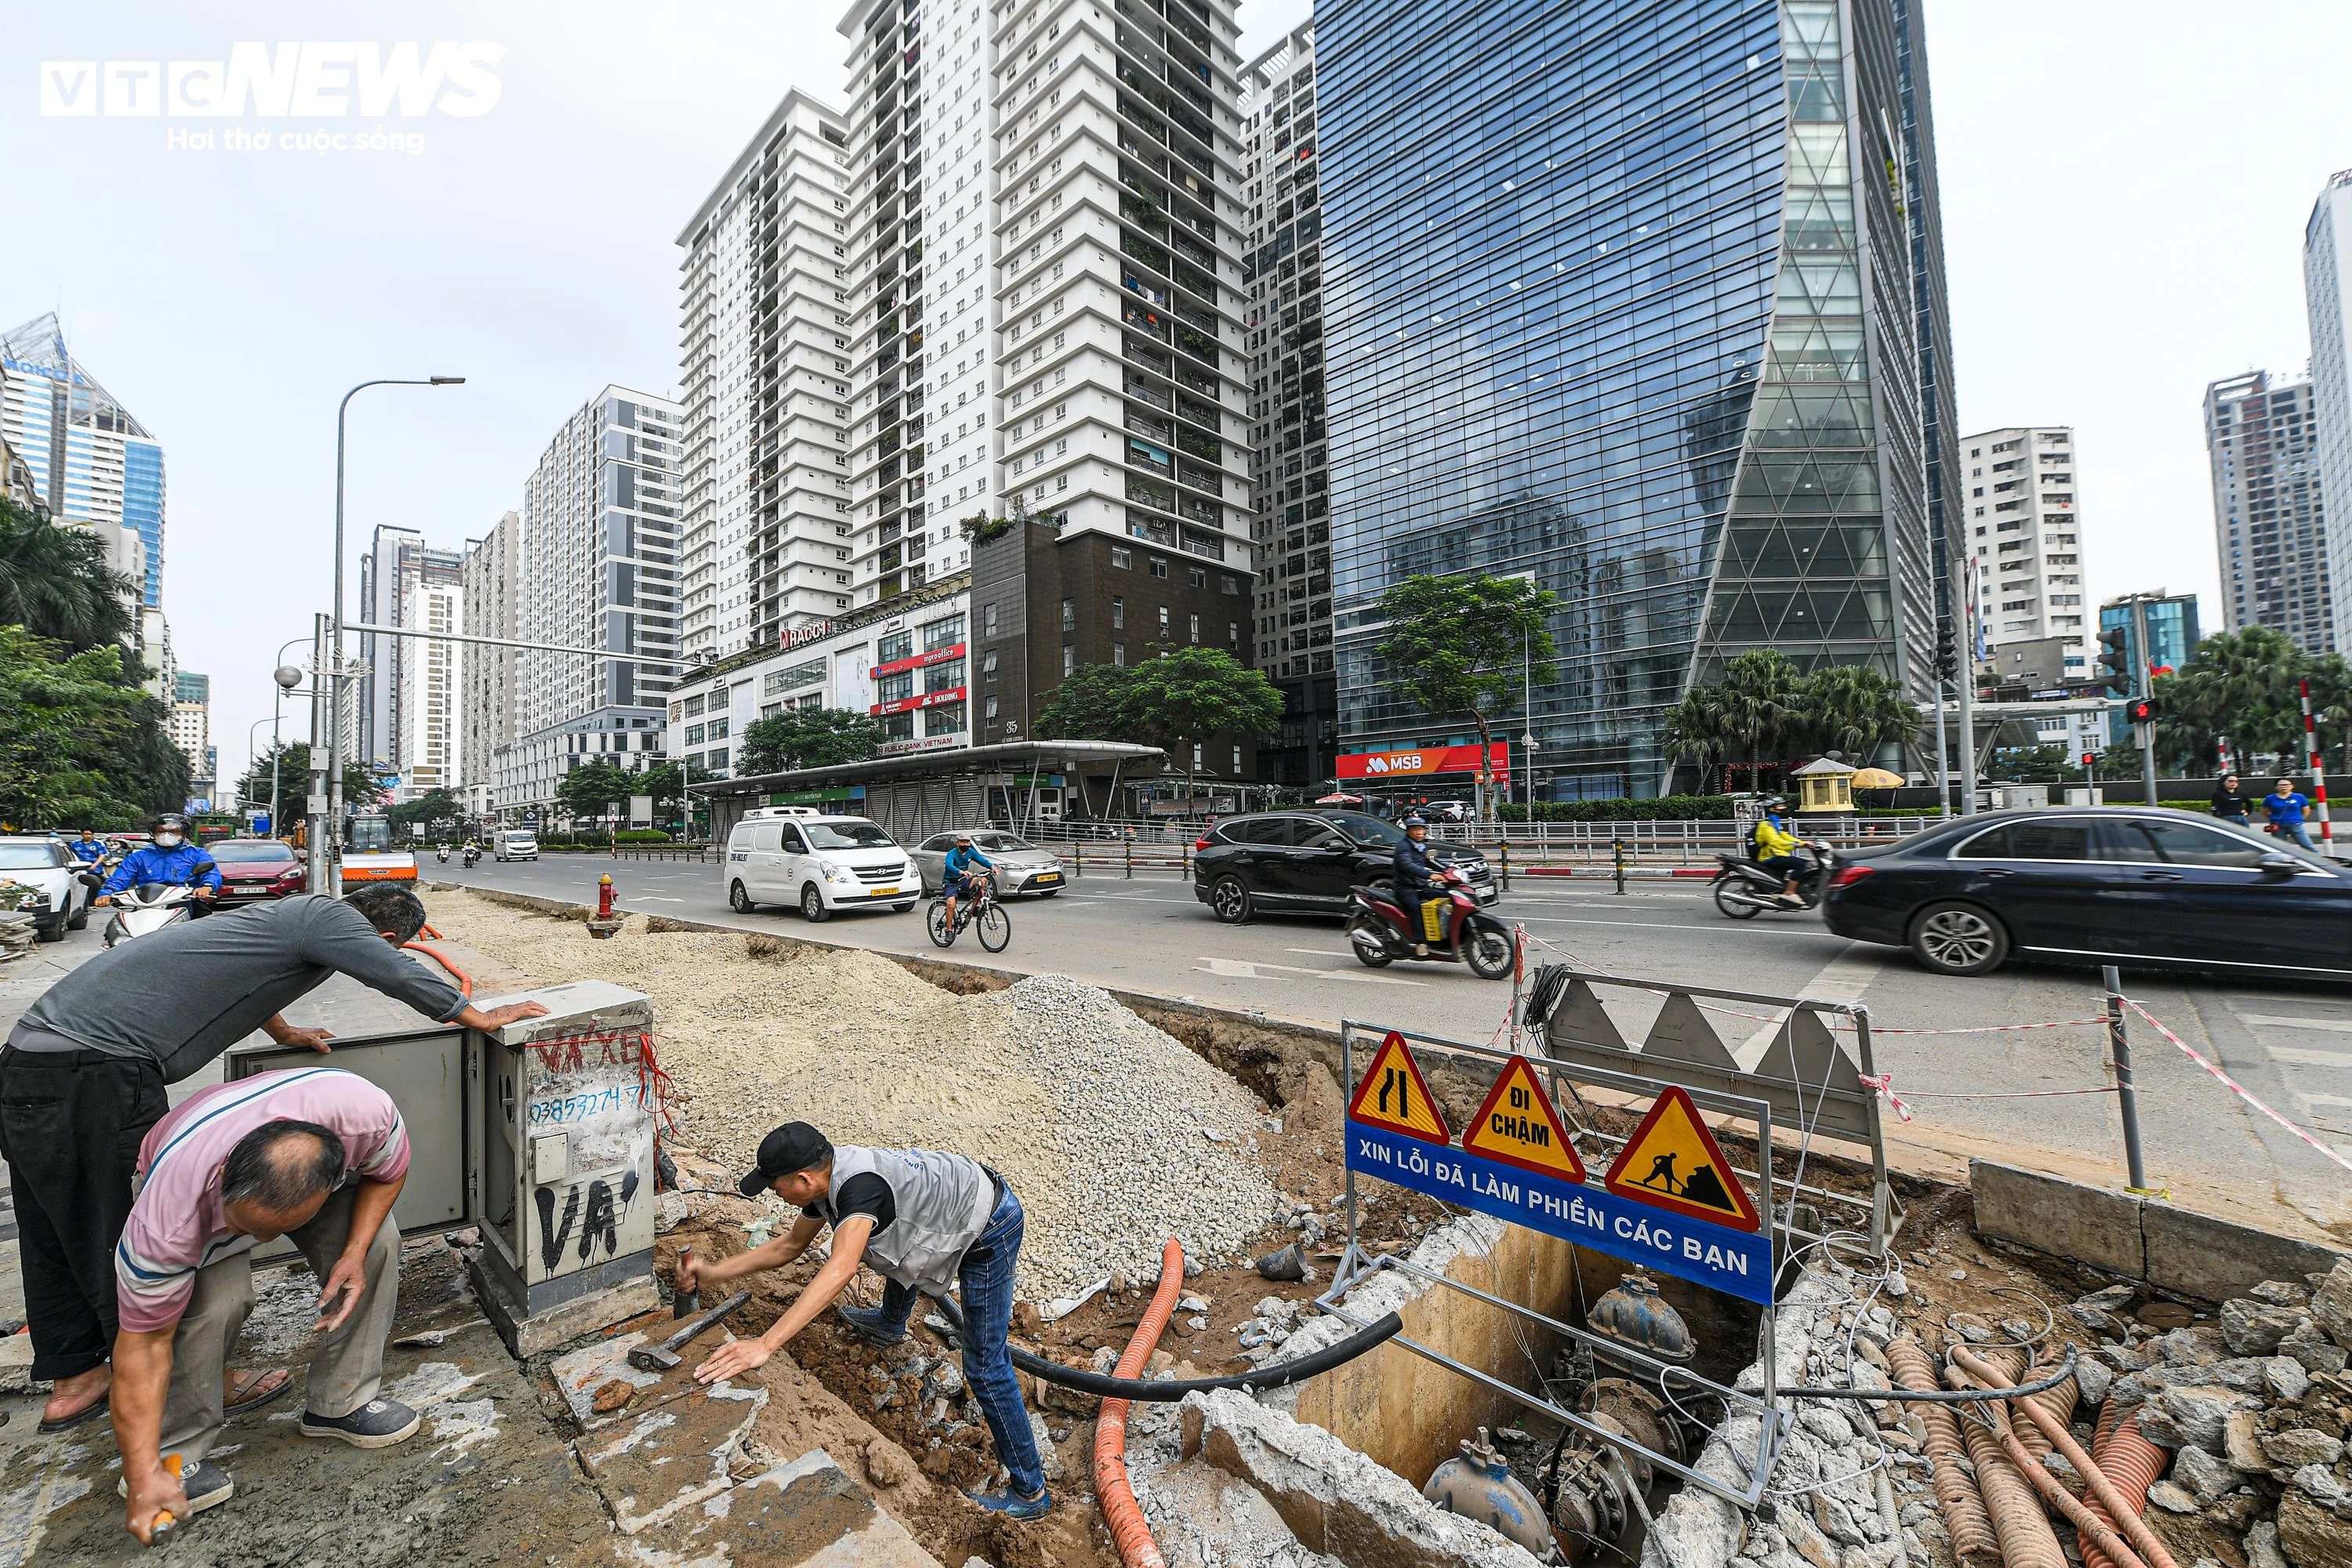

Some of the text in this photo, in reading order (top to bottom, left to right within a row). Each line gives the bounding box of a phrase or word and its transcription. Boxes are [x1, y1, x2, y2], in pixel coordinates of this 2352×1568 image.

[1006, 720, 1018, 735] 35
[884, 737, 953, 753] PUBLIC BANK VIETNAM
[1390, 755, 1422, 771] MSB
[1509, 1086, 1530, 1111] ĐI
[1491, 1112, 1550, 1147] CHẬM
[1359, 1138, 1748, 1276] XIN LỖI ĐÃ LÀM PHIỀN CÁC BẠN
